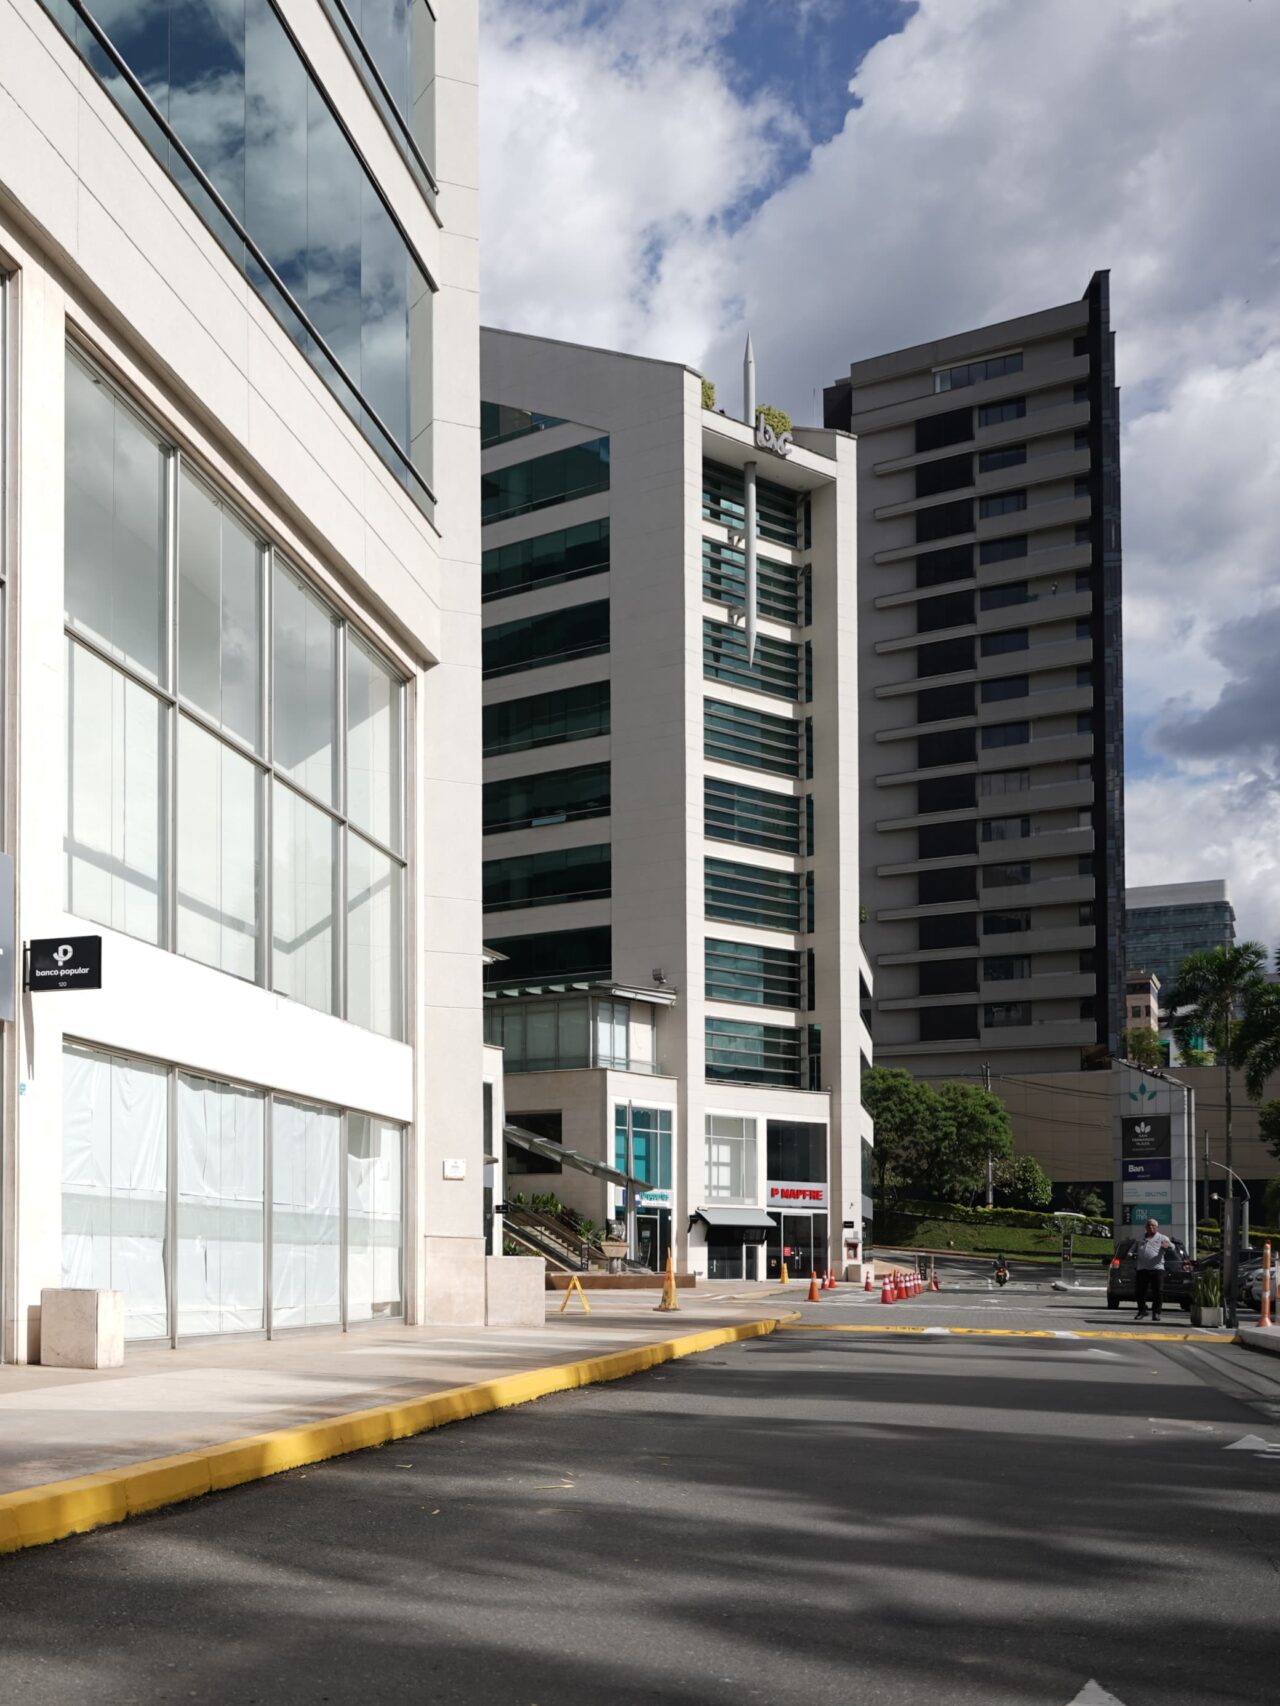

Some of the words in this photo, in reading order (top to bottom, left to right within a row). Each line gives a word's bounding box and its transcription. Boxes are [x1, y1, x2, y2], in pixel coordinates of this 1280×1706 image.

[35, 969, 59, 977] banco
[59, 967, 90, 977] popular
[780, 1188, 824, 1201] MAPFRE
